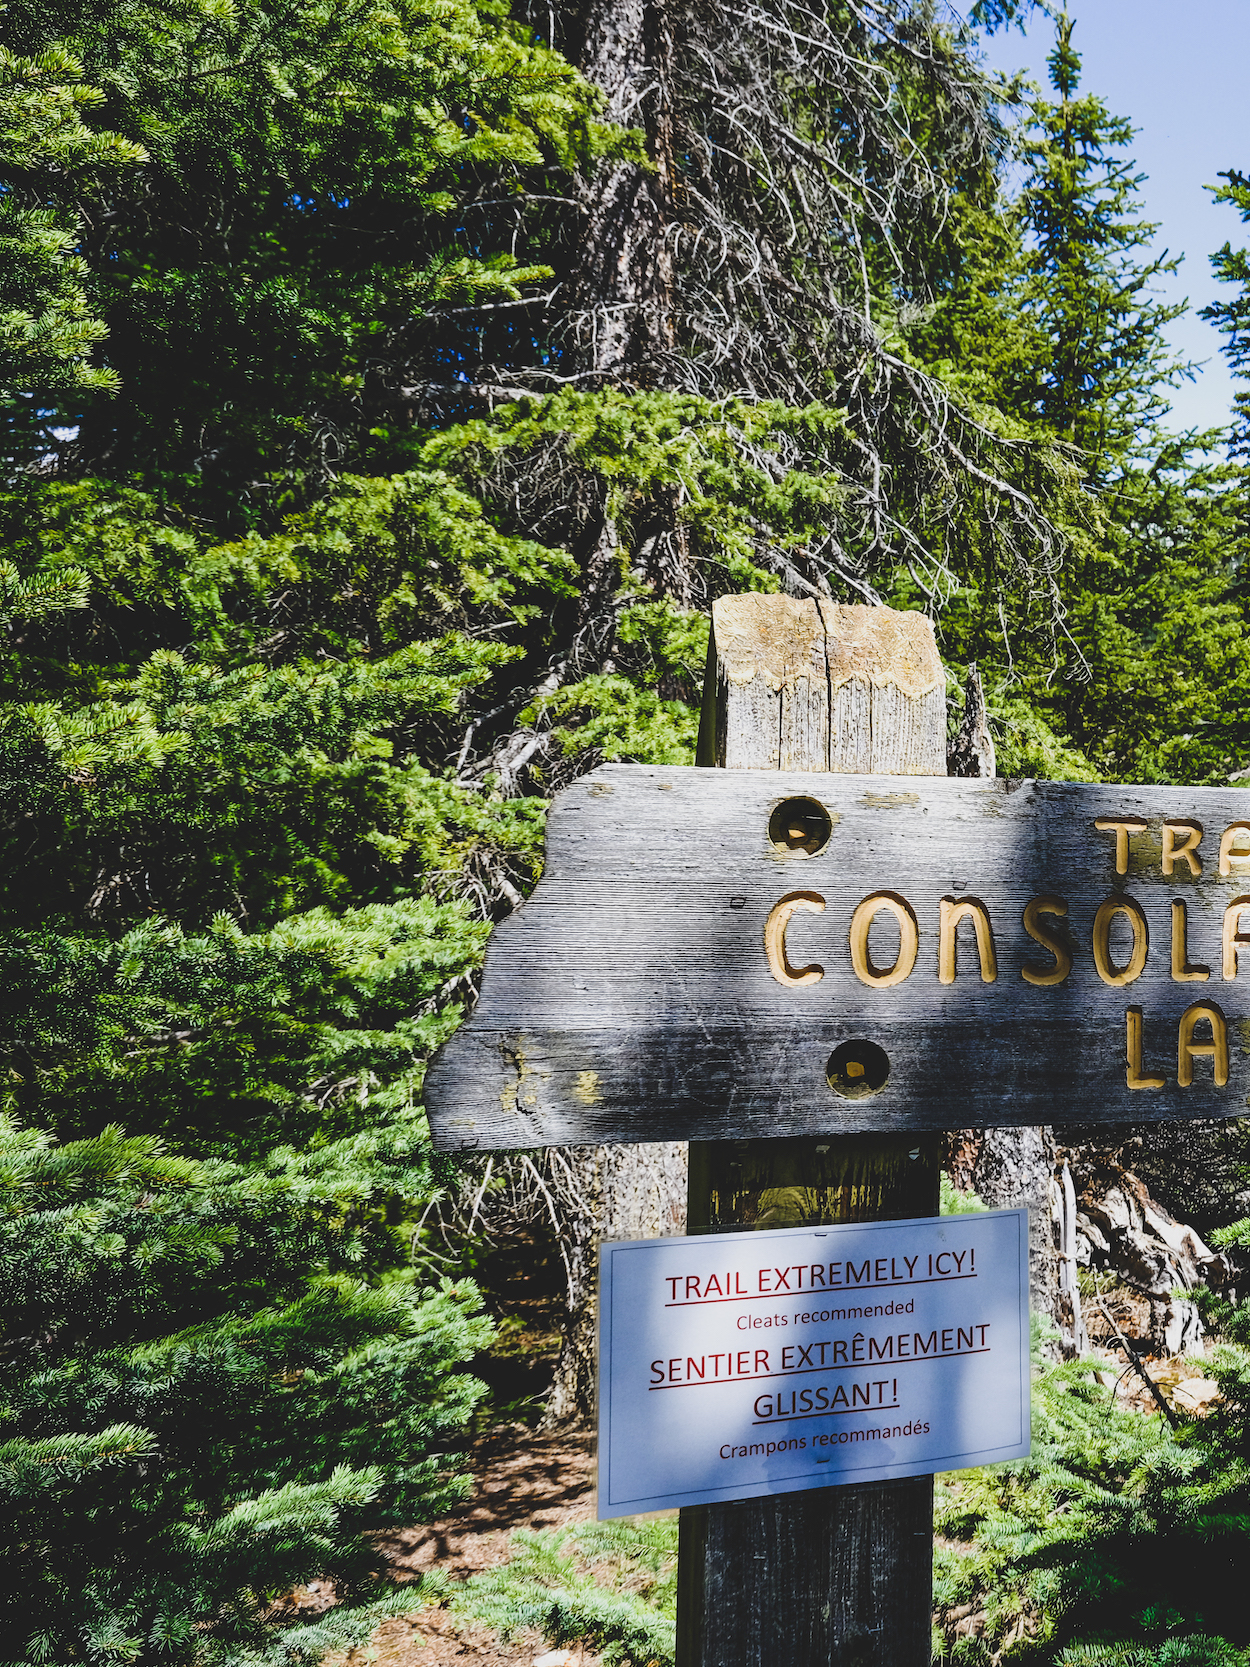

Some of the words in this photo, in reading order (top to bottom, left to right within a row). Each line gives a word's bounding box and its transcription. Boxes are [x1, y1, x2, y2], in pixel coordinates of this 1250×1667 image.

[665, 1271, 748, 1301] TRAIL
[758, 1255, 920, 1293] EXTREMELY
[928, 1248, 977, 1277] ICY!
[736, 1314, 789, 1331] Cleats
[794, 1298, 915, 1325] recommended
[650, 1349, 771, 1384] SENTIER
[781, 1324, 991, 1370] EXTRÊMEMENT
[753, 1378, 899, 1418] GLISSANT!
[719, 1436, 807, 1460] Crampons
[812, 1420, 931, 1447] recommandés
